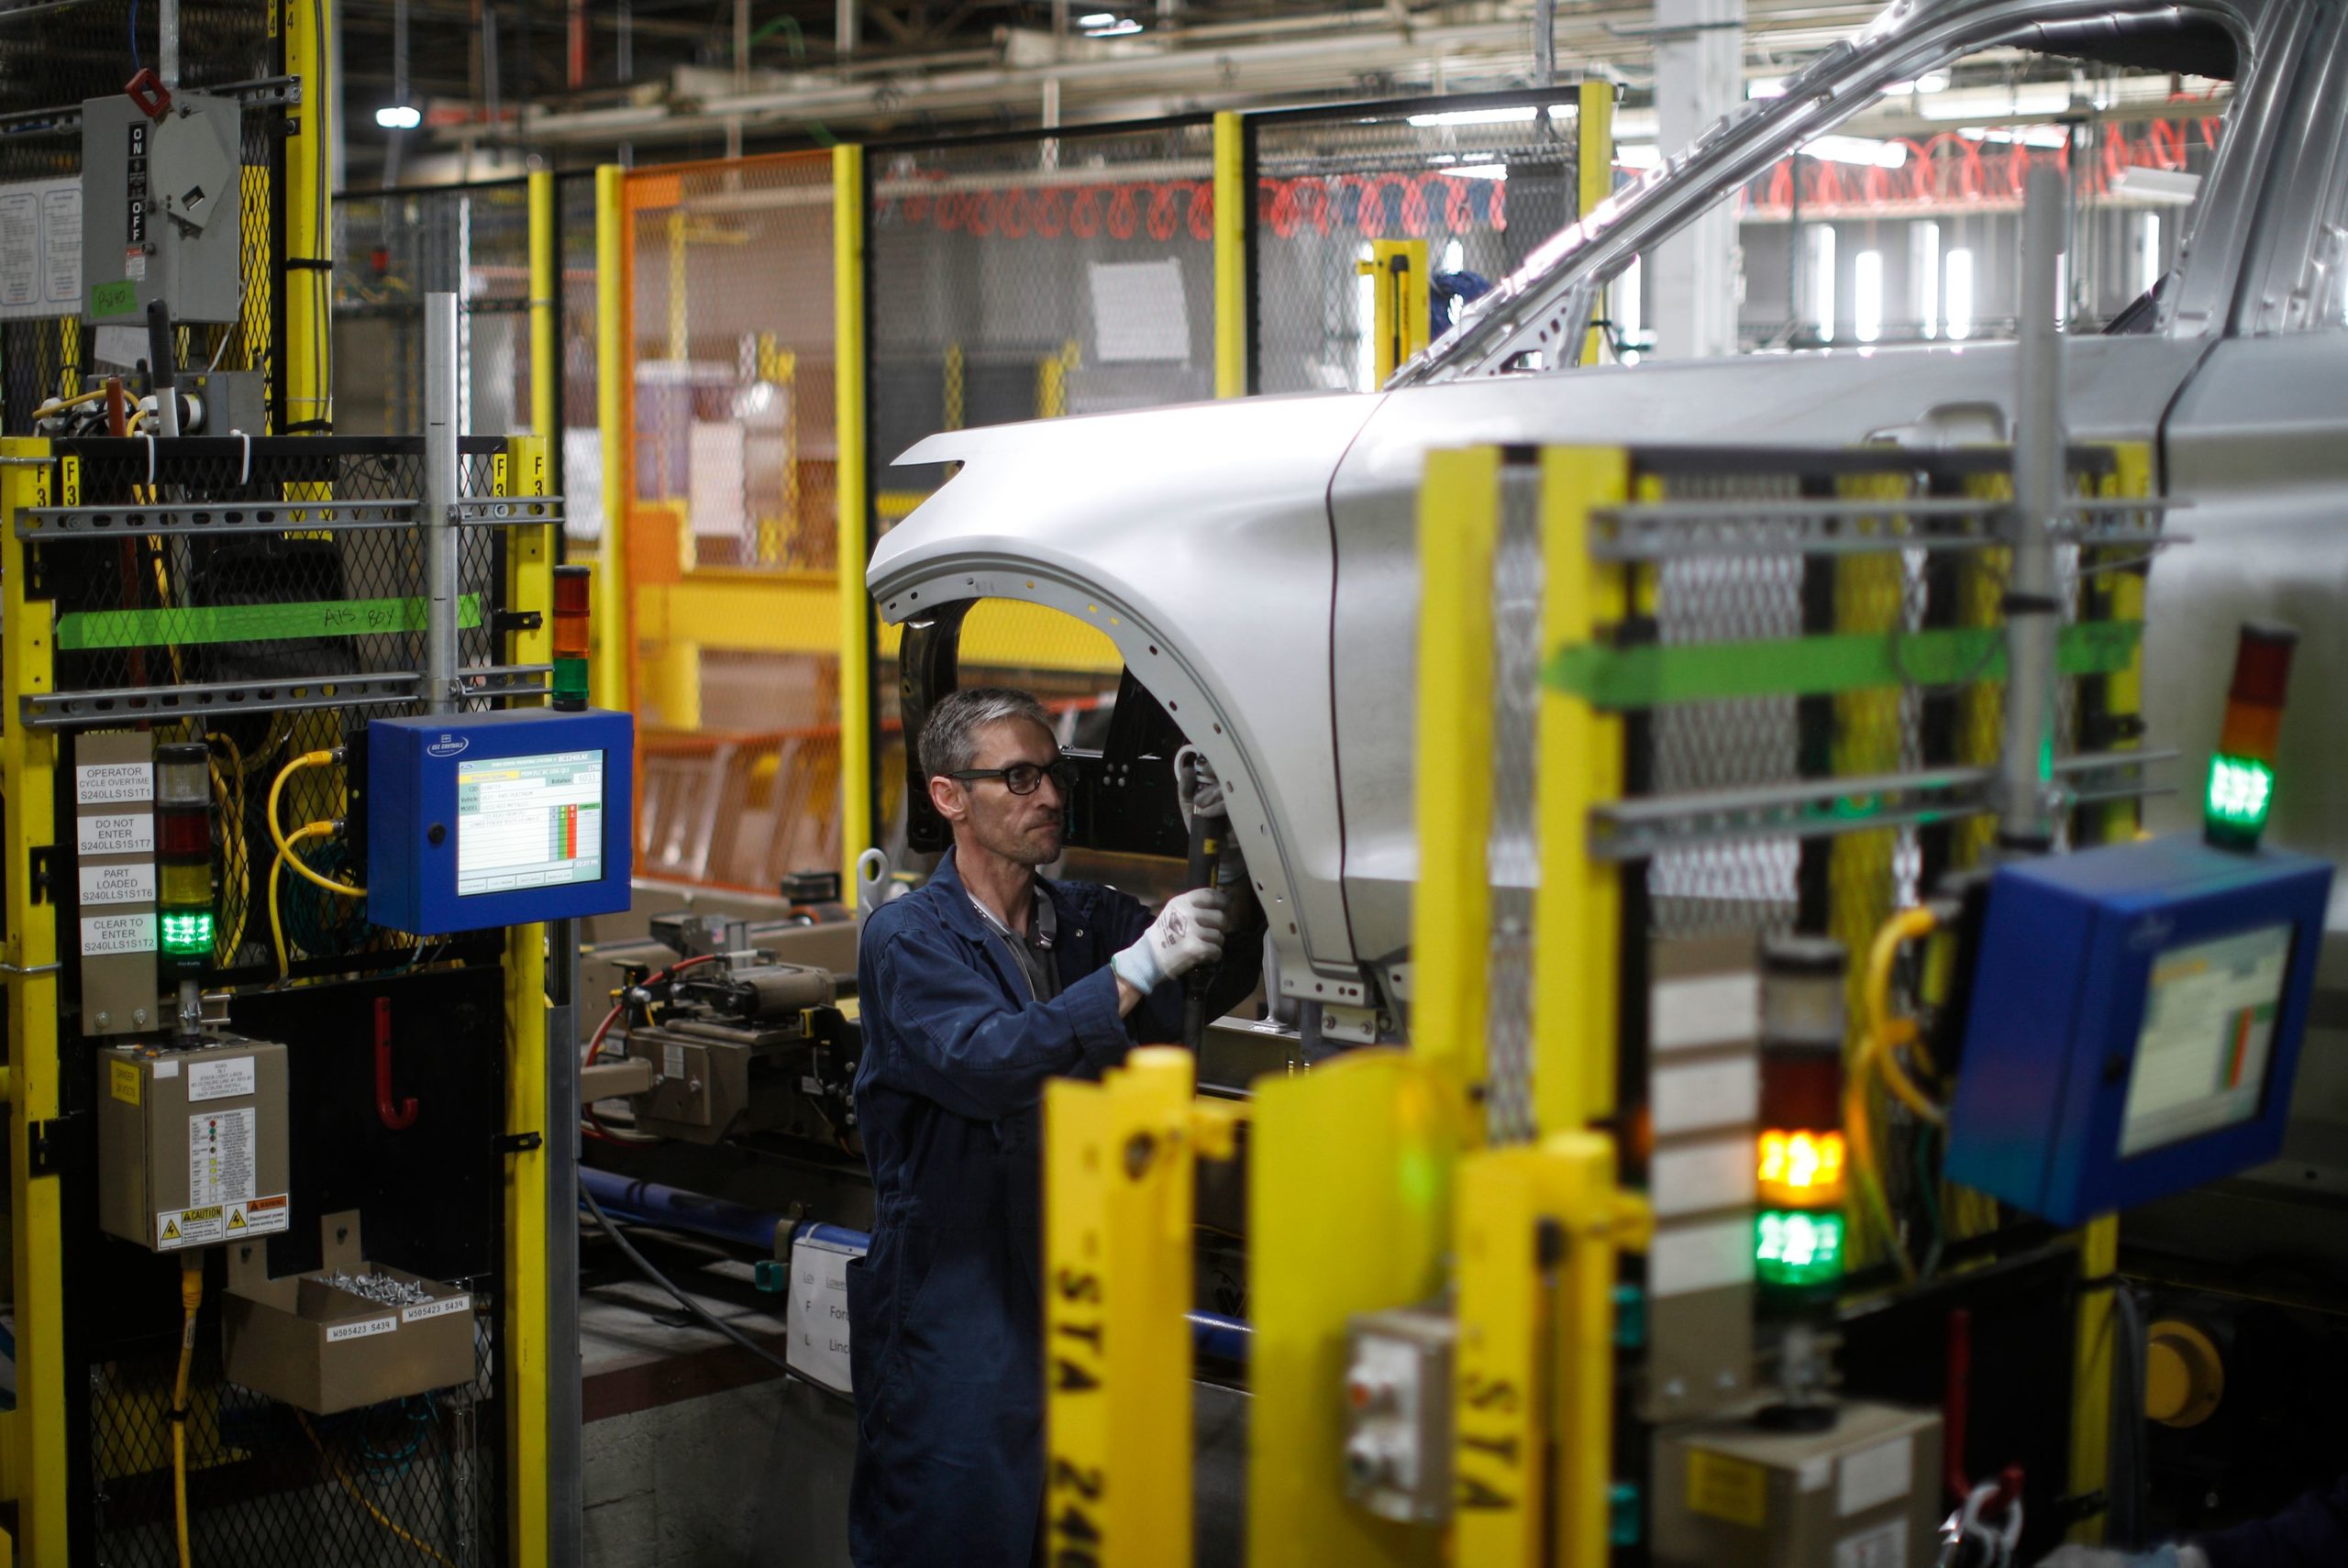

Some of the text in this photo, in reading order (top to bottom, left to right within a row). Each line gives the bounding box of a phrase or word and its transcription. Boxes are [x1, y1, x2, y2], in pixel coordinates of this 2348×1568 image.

[133, 127, 142, 155] ON
[132, 203, 140, 241] OFF
[87, 767, 142, 778] OPERATOR
[79, 777, 150, 789] CYCLE OVERTIME
[81, 789, 150, 801] S240LLS1S1T1
[95, 818, 135, 828] DO NOT
[98, 830, 132, 839] ENTER
[81, 839, 151, 851] S240LLS1S1T7
[104, 868, 129, 878] PART
[96, 879, 138, 889] LOADED
[83, 889, 153, 901] S240LLS1S1T6
[94, 918, 144, 930] CLEAR TO
[102, 930, 136, 940] ENTER
[84, 939, 155, 952] S240LLS1S1T2
[191, 1208, 221, 1221] CAUTION
[408, 1304, 441, 1319] W505423
[333, 1325, 367, 1338] W505423
[1058, 1269, 1102, 1395] STA
